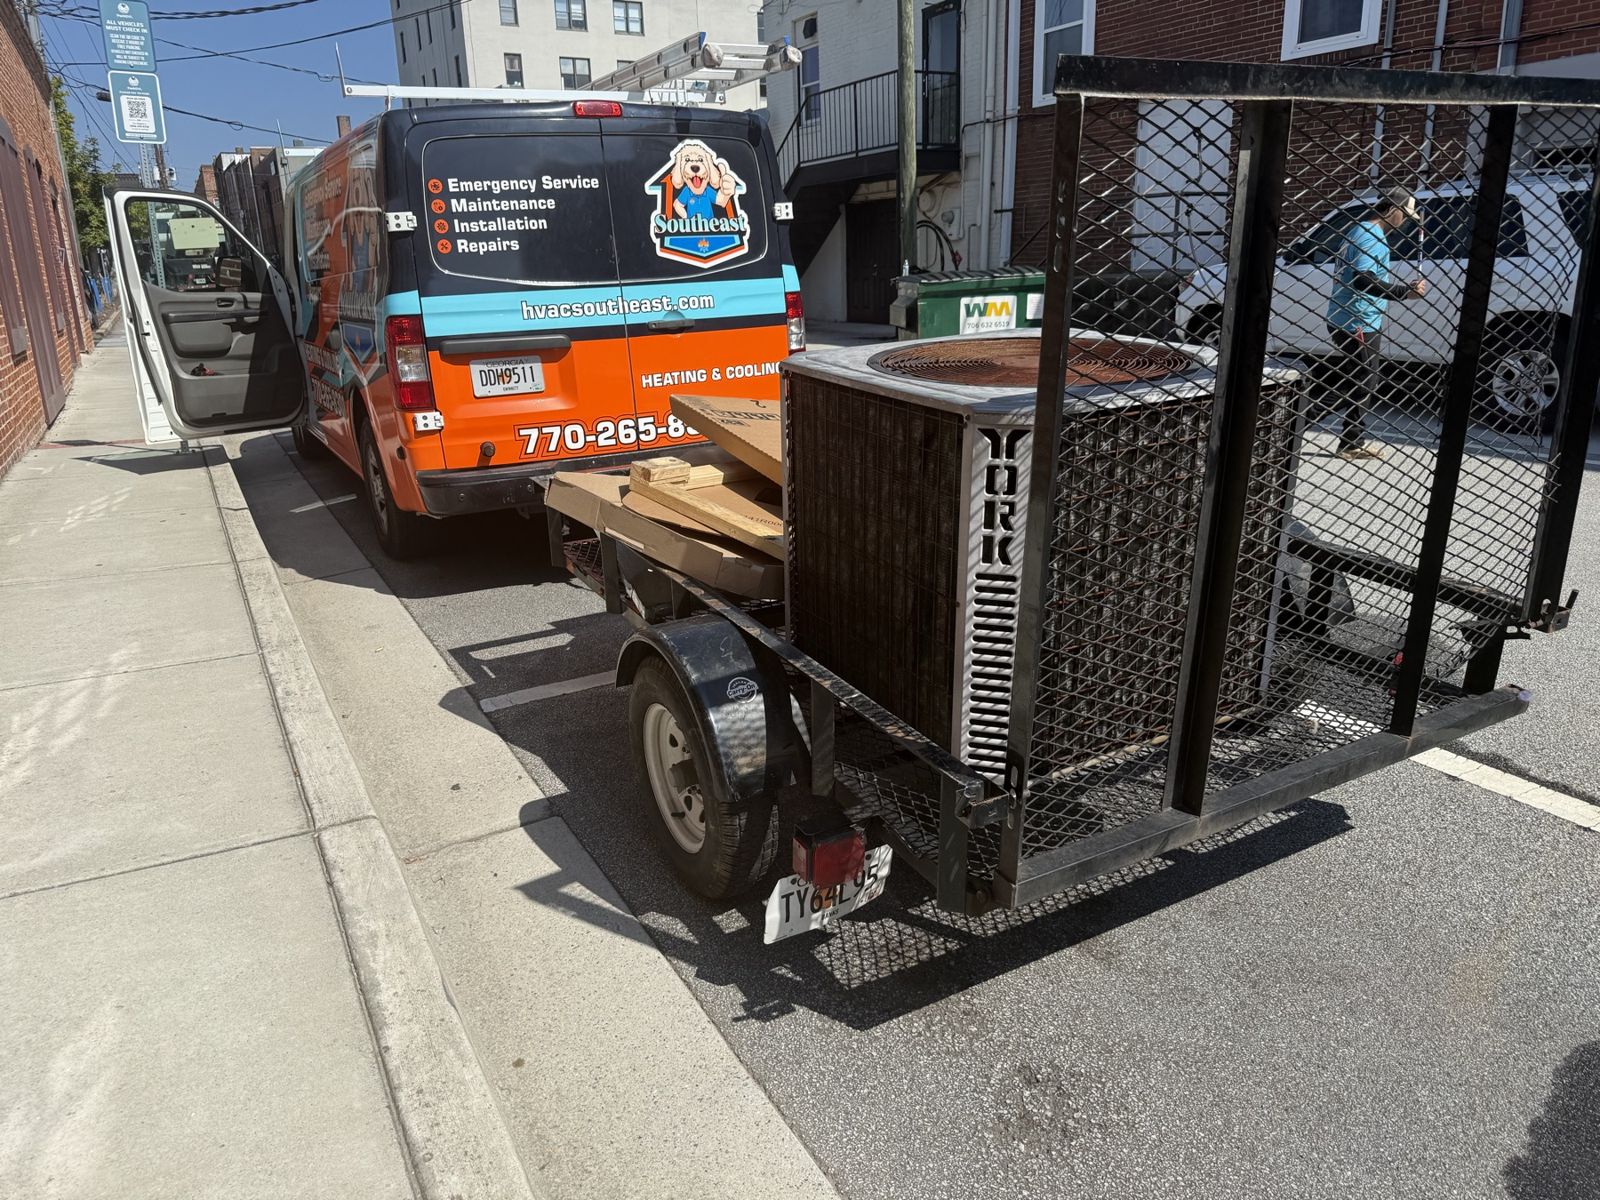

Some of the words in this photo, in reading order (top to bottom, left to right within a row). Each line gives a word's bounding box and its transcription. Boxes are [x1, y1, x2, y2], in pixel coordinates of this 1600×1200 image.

[447, 176, 537, 195] Emergency
[541, 174, 600, 190] Service
[450, 196, 556, 213] Maintenance
[453, 216, 548, 233] Installation
[654, 213, 748, 236] Southeast
[456, 238, 520, 255] Repairs
[521, 294, 715, 321] hvacsoutheast.com
[964, 301, 1011, 317] WM
[966, 321, 980, 329] 706
[994, 320, 1010, 328] 6519
[485, 359, 525, 368] GEORGIA
[479, 365, 535, 387] DDH9511
[641, 370, 706, 389] HEATING
[711, 367, 722, 381] &
[977, 427, 1032, 566] YORK
[727, 683, 757, 697] Carry-On
[781, 863, 878, 923] TY64L95
